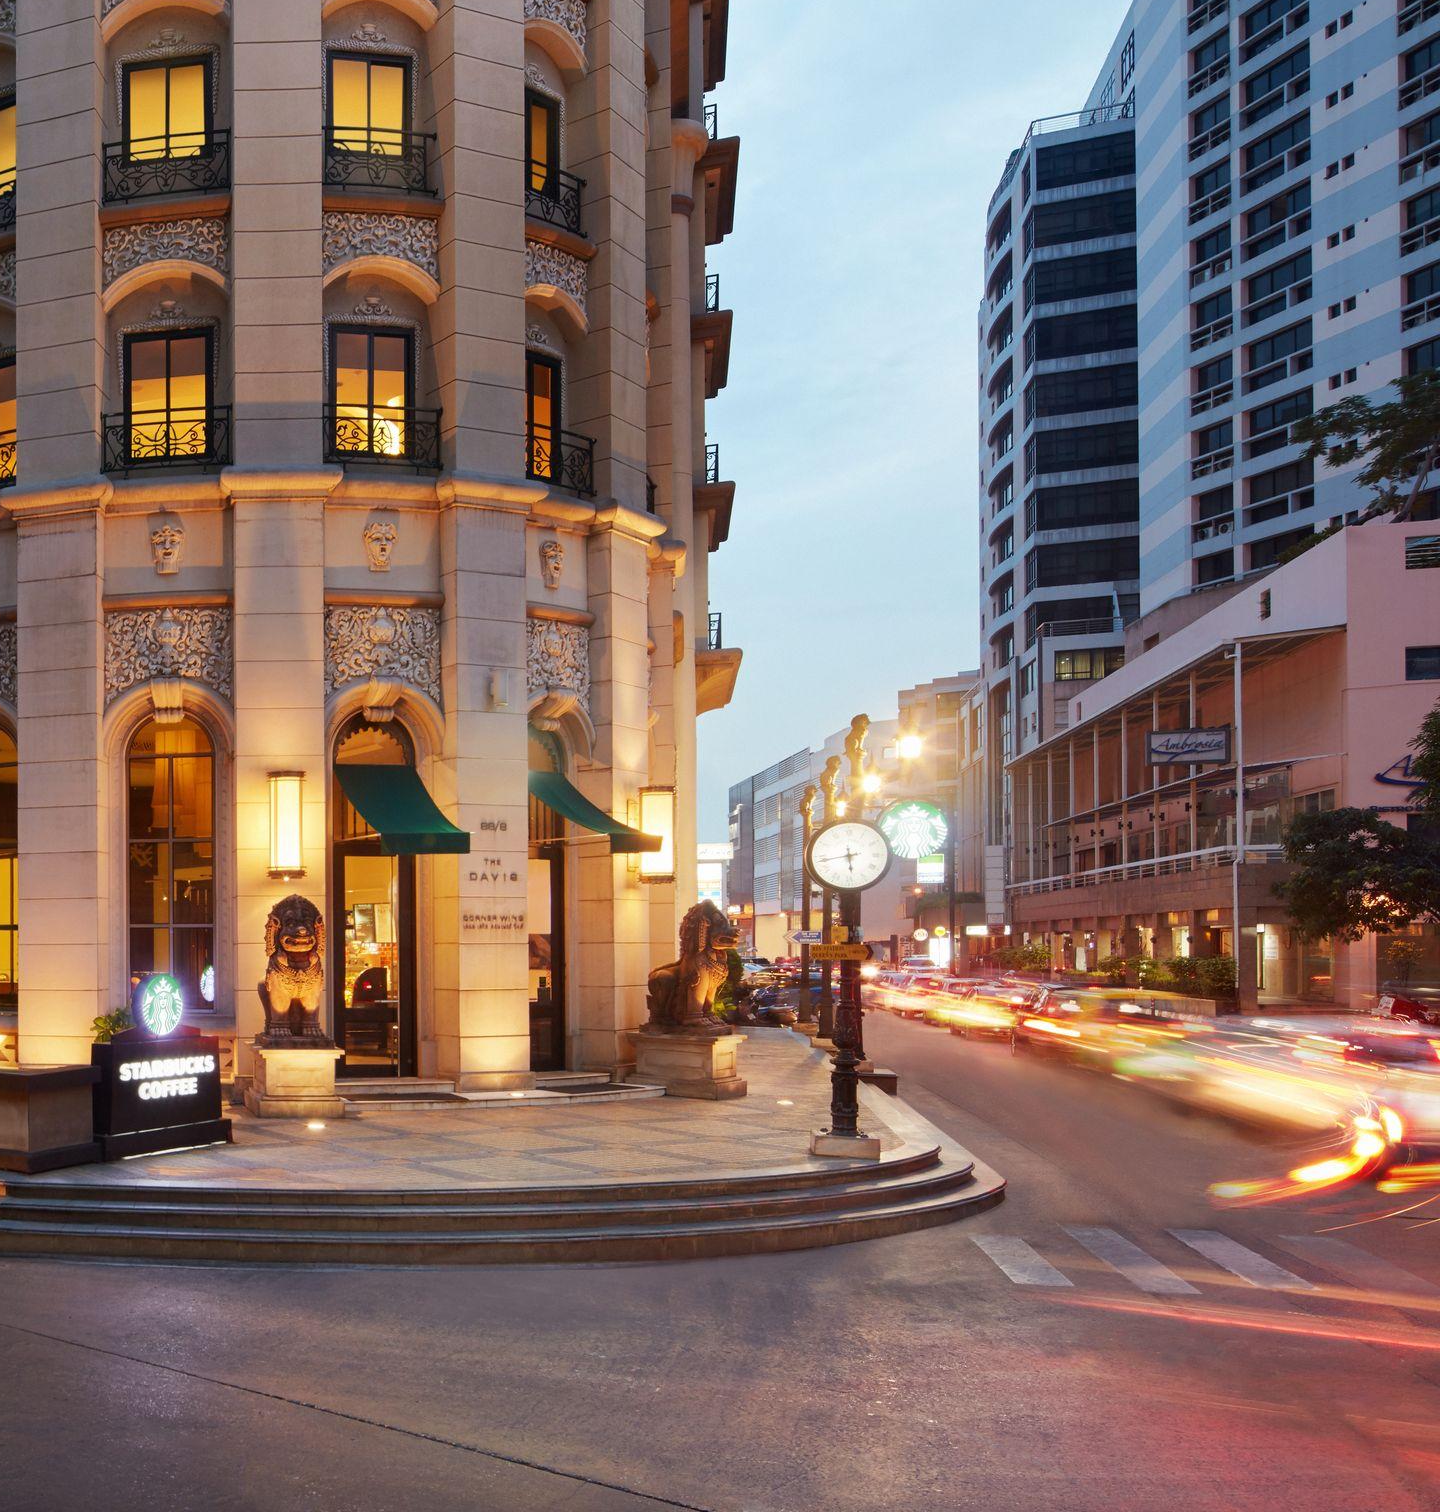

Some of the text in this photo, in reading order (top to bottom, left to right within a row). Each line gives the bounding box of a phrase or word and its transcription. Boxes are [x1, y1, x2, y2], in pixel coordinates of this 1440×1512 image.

[1154, 732, 1224, 752] Ambrosia
[484, 858, 501, 866] THE
[469, 872, 518, 882] DAVIS
[463, 914, 524, 922] CORNER WING
[119, 1055, 215, 1082] STARBUCKS
[138, 1077, 198, 1100] COFFEE
